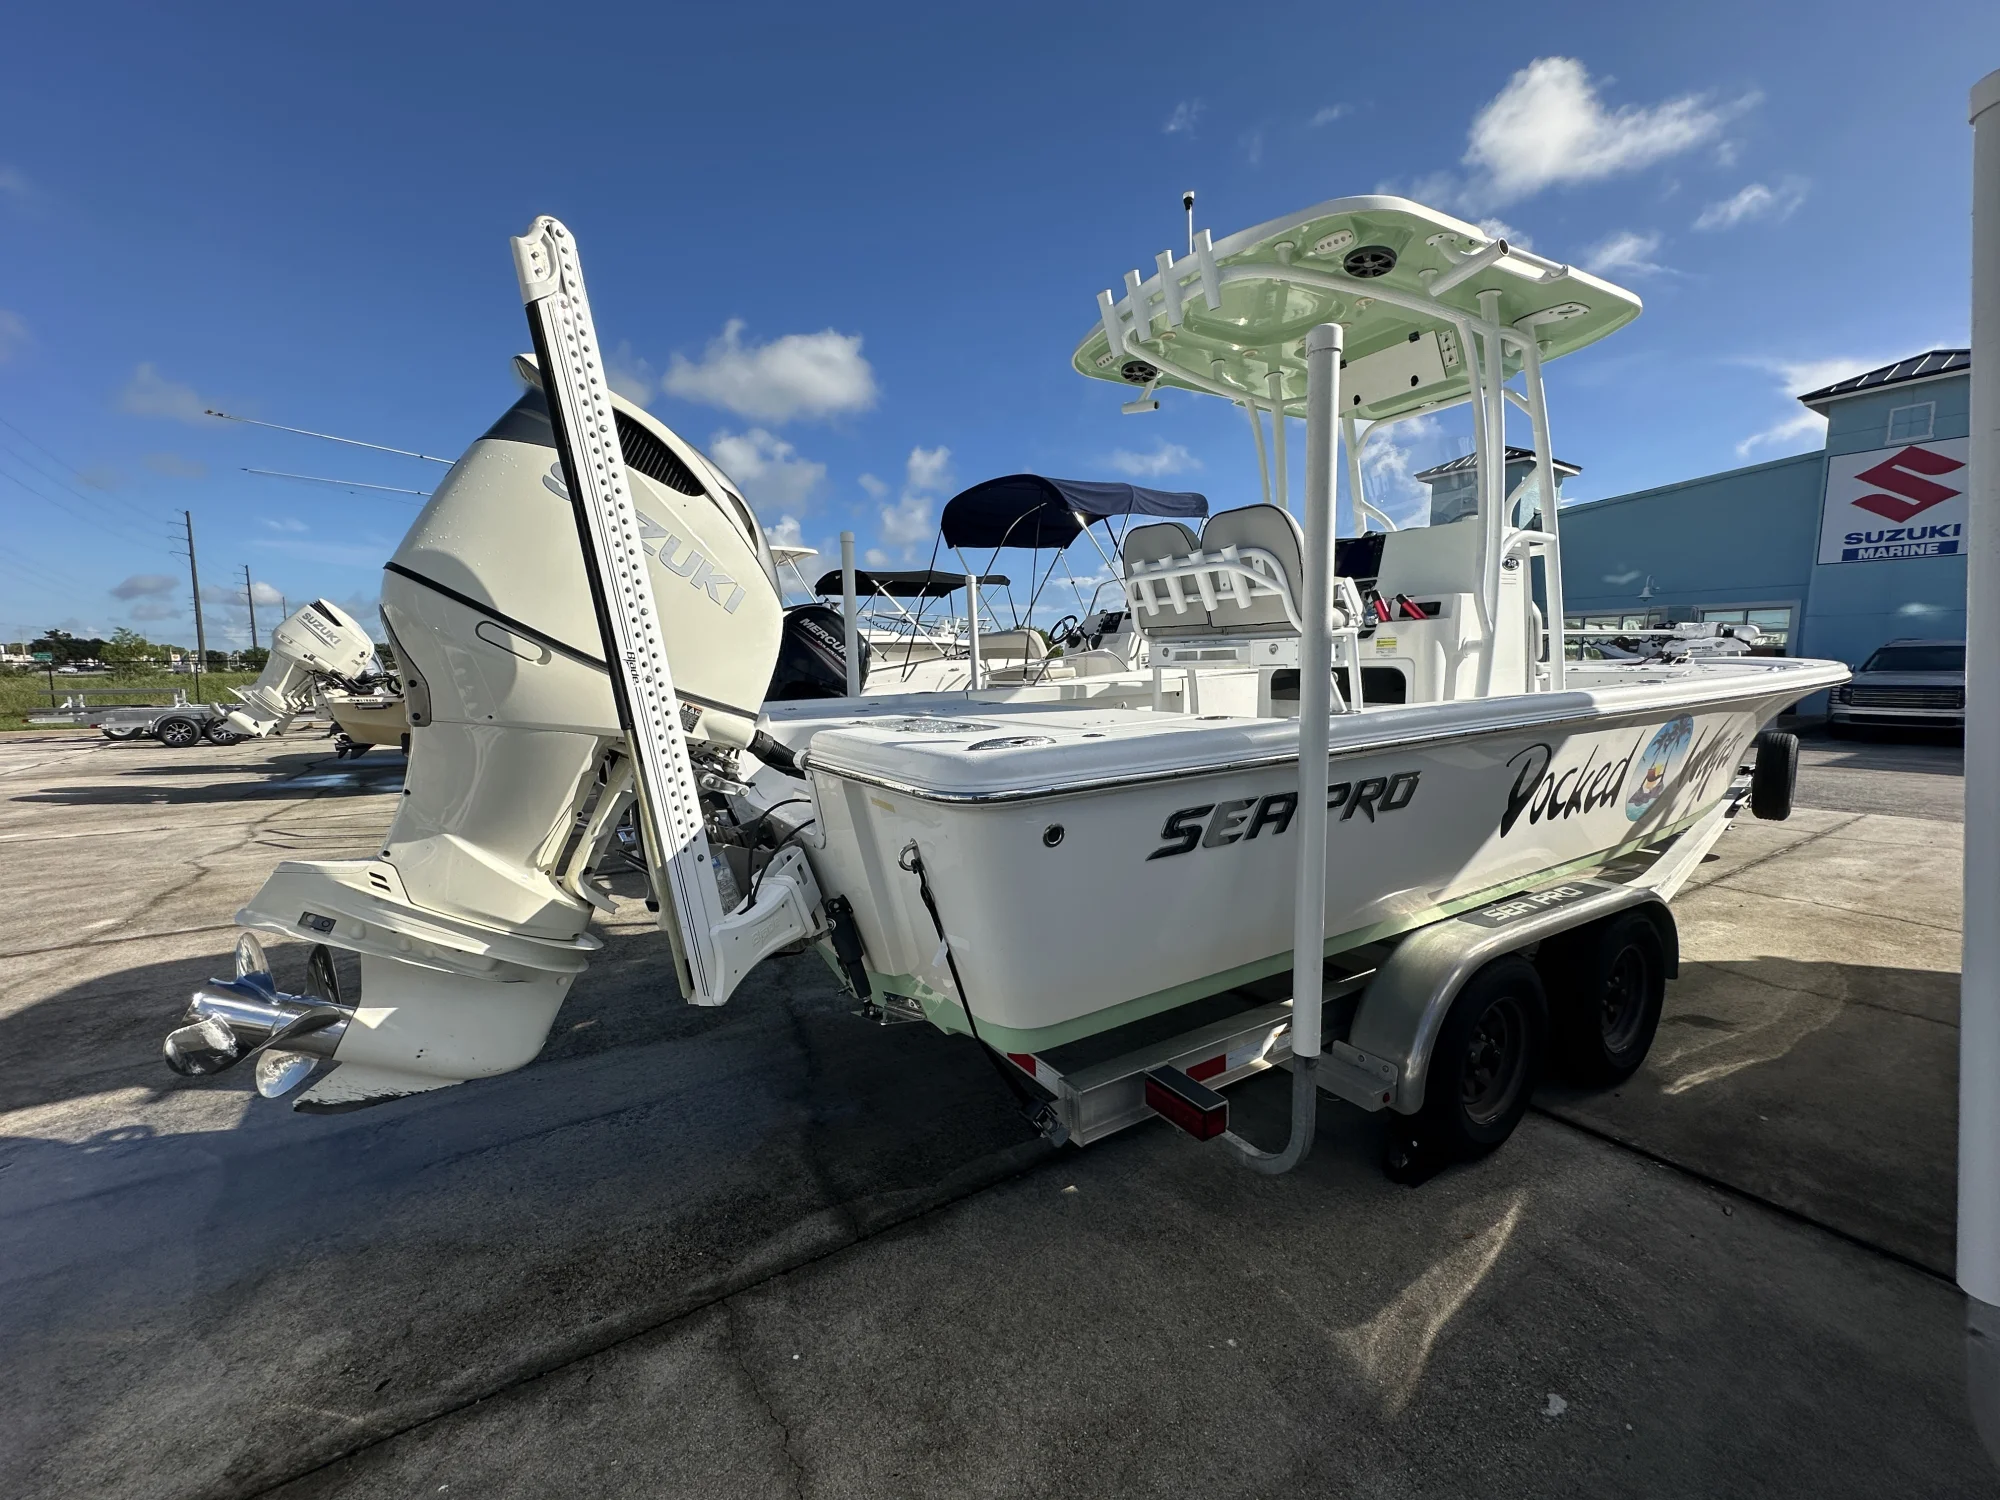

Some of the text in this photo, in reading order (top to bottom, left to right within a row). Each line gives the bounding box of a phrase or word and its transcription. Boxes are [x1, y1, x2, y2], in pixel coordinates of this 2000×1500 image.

[542, 461, 746, 614] SZUKI
[1844, 523, 1961, 545] SUZUKI
[1857, 542, 1940, 560] MARINE
[301, 612, 342, 645] SUZUKI
[800, 618, 847, 656] MERCUR
[623, 651, 640, 684] Blade
[1500, 729, 1646, 838] Docked
[1145, 791, 1298, 861] SEA
[1483, 886, 1583, 921] SEA PRO
